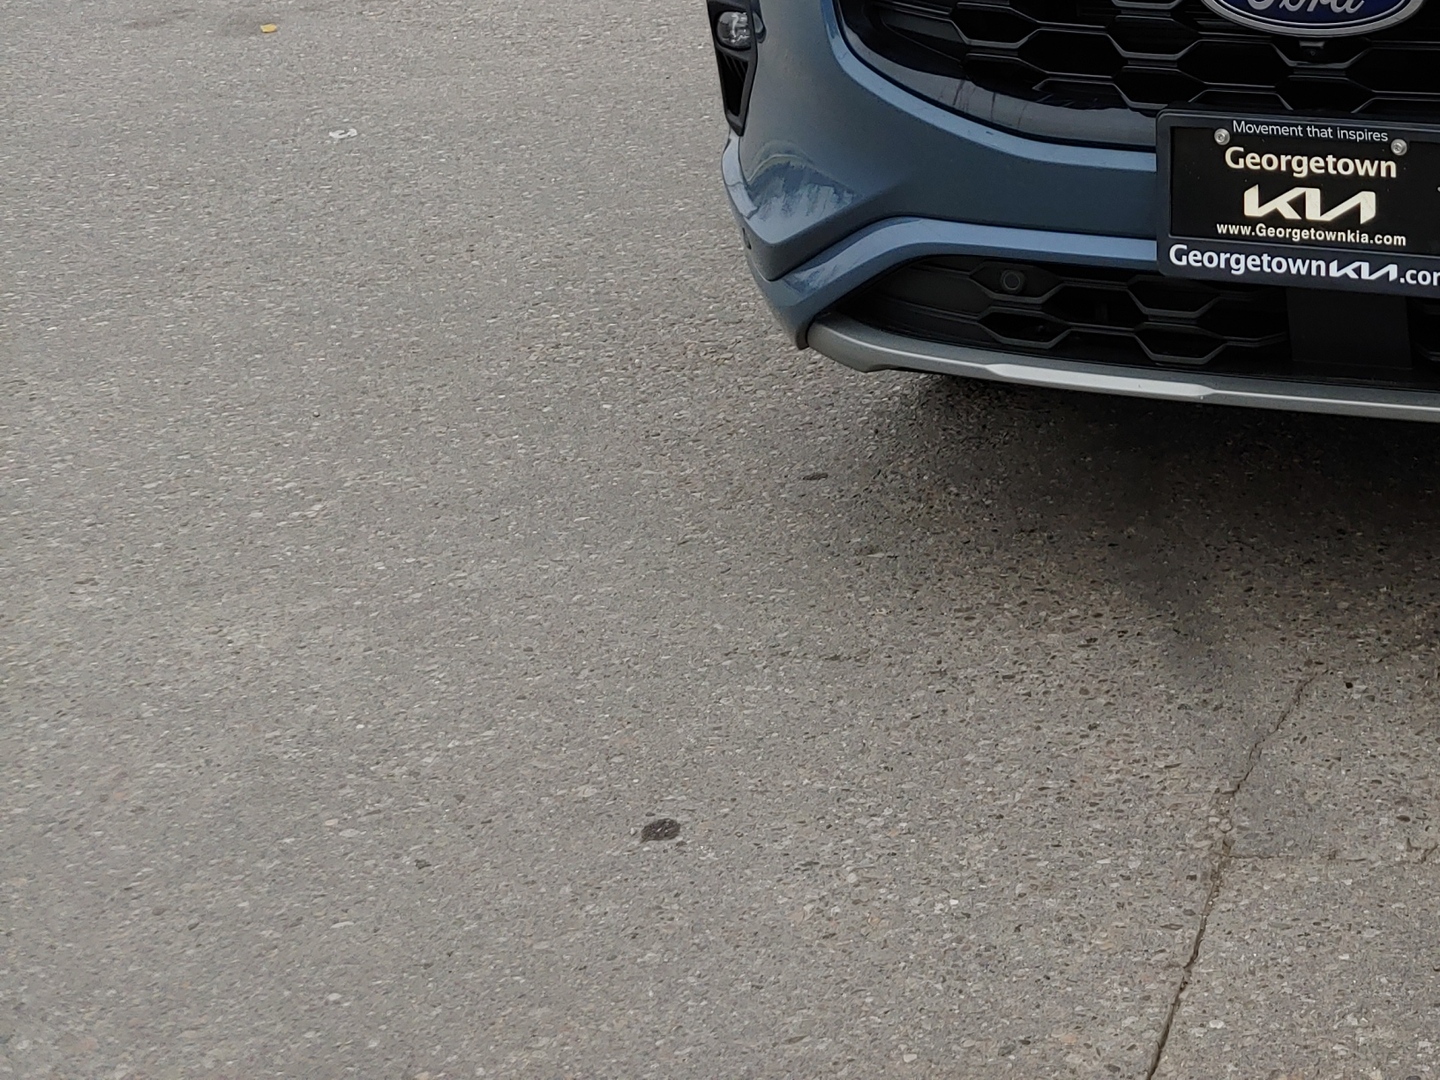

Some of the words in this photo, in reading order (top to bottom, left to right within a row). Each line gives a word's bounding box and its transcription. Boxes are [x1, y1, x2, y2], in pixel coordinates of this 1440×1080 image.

[1233, 120, 1303, 137] Movement
[1306, 124, 1333, 139] that
[1337, 128, 1389, 143] inspires
[1225, 146, 1397, 178] Georgetown
[1244, 184, 1376, 225] KIA
[1216, 223, 1407, 246] www.Georgetownkia.com
